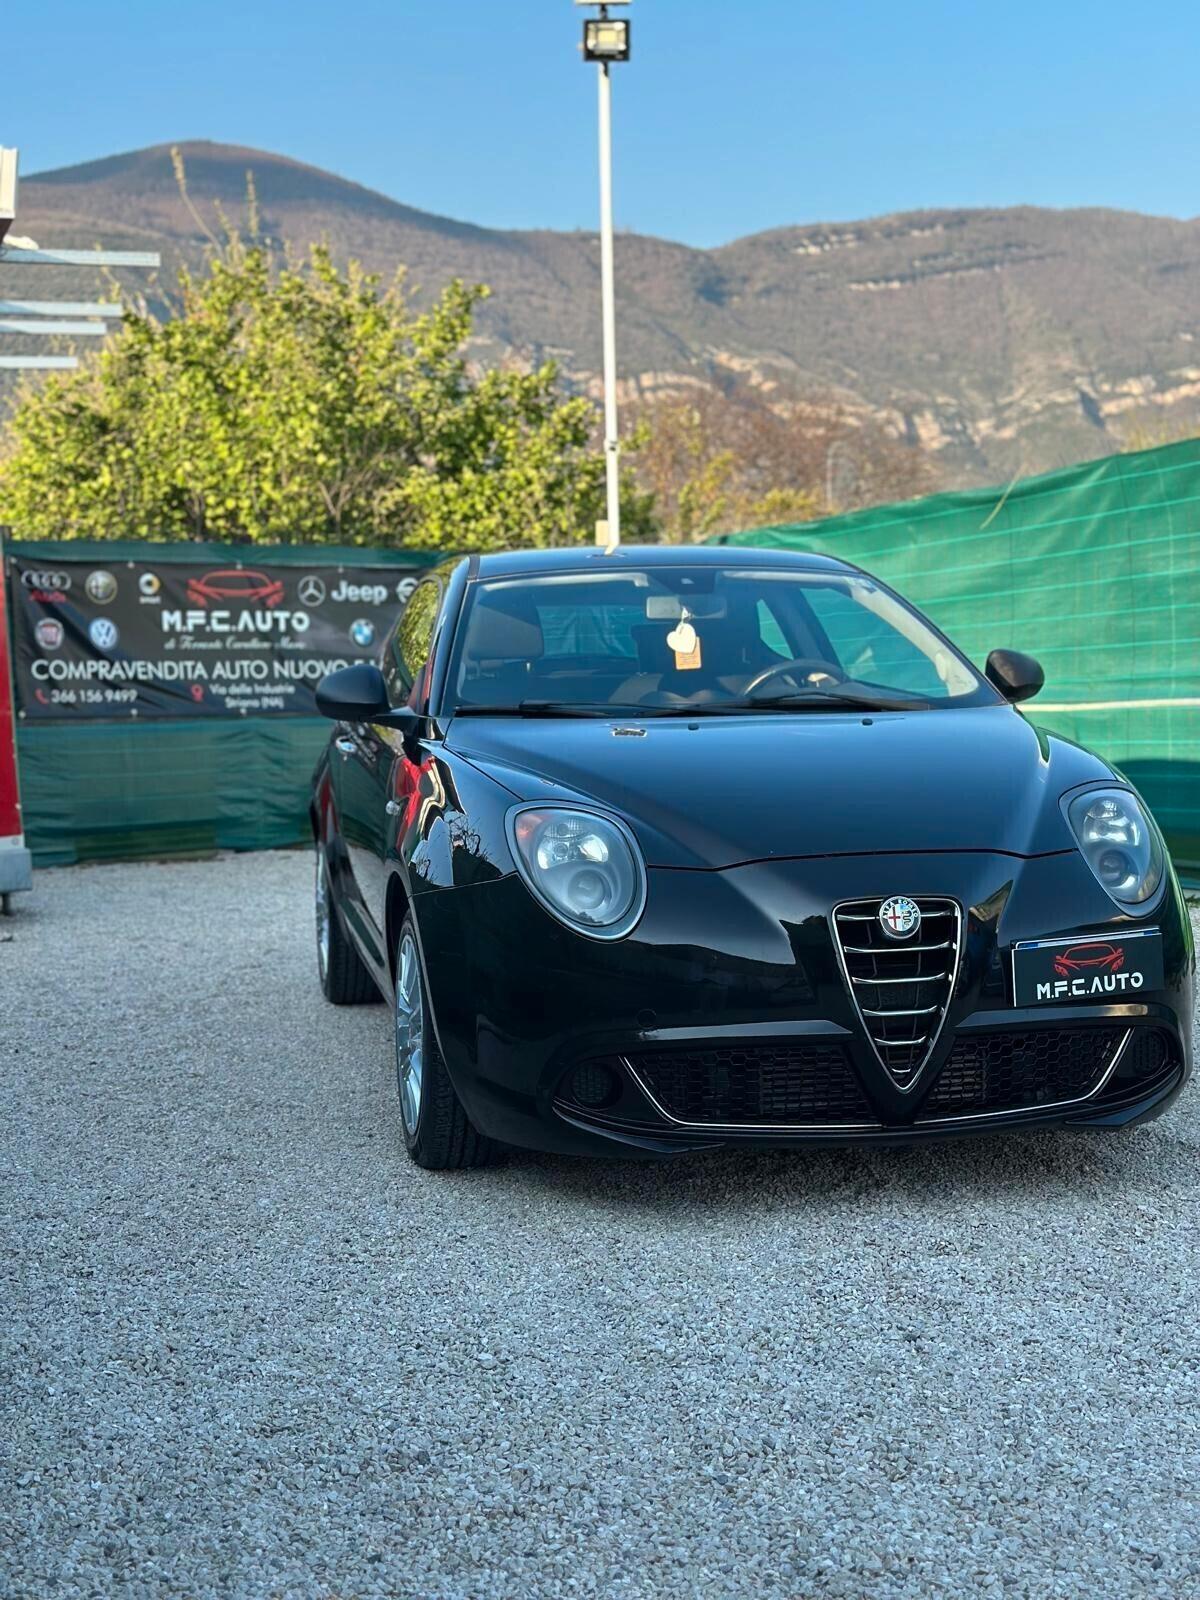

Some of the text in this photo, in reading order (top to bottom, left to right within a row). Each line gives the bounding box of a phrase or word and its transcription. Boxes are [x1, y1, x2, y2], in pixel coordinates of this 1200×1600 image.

[331, 580, 388, 606] Jeep
[161, 610, 310, 632] M.F.C.AUTO
[31, 659, 208, 681] COMPRAVENDITA
[212, 660, 268, 680] AUTO
[51, 689, 76, 703] 366
[80, 689, 102, 703] 156
[1036, 972, 1144, 1000] M.F.C.AUTO
